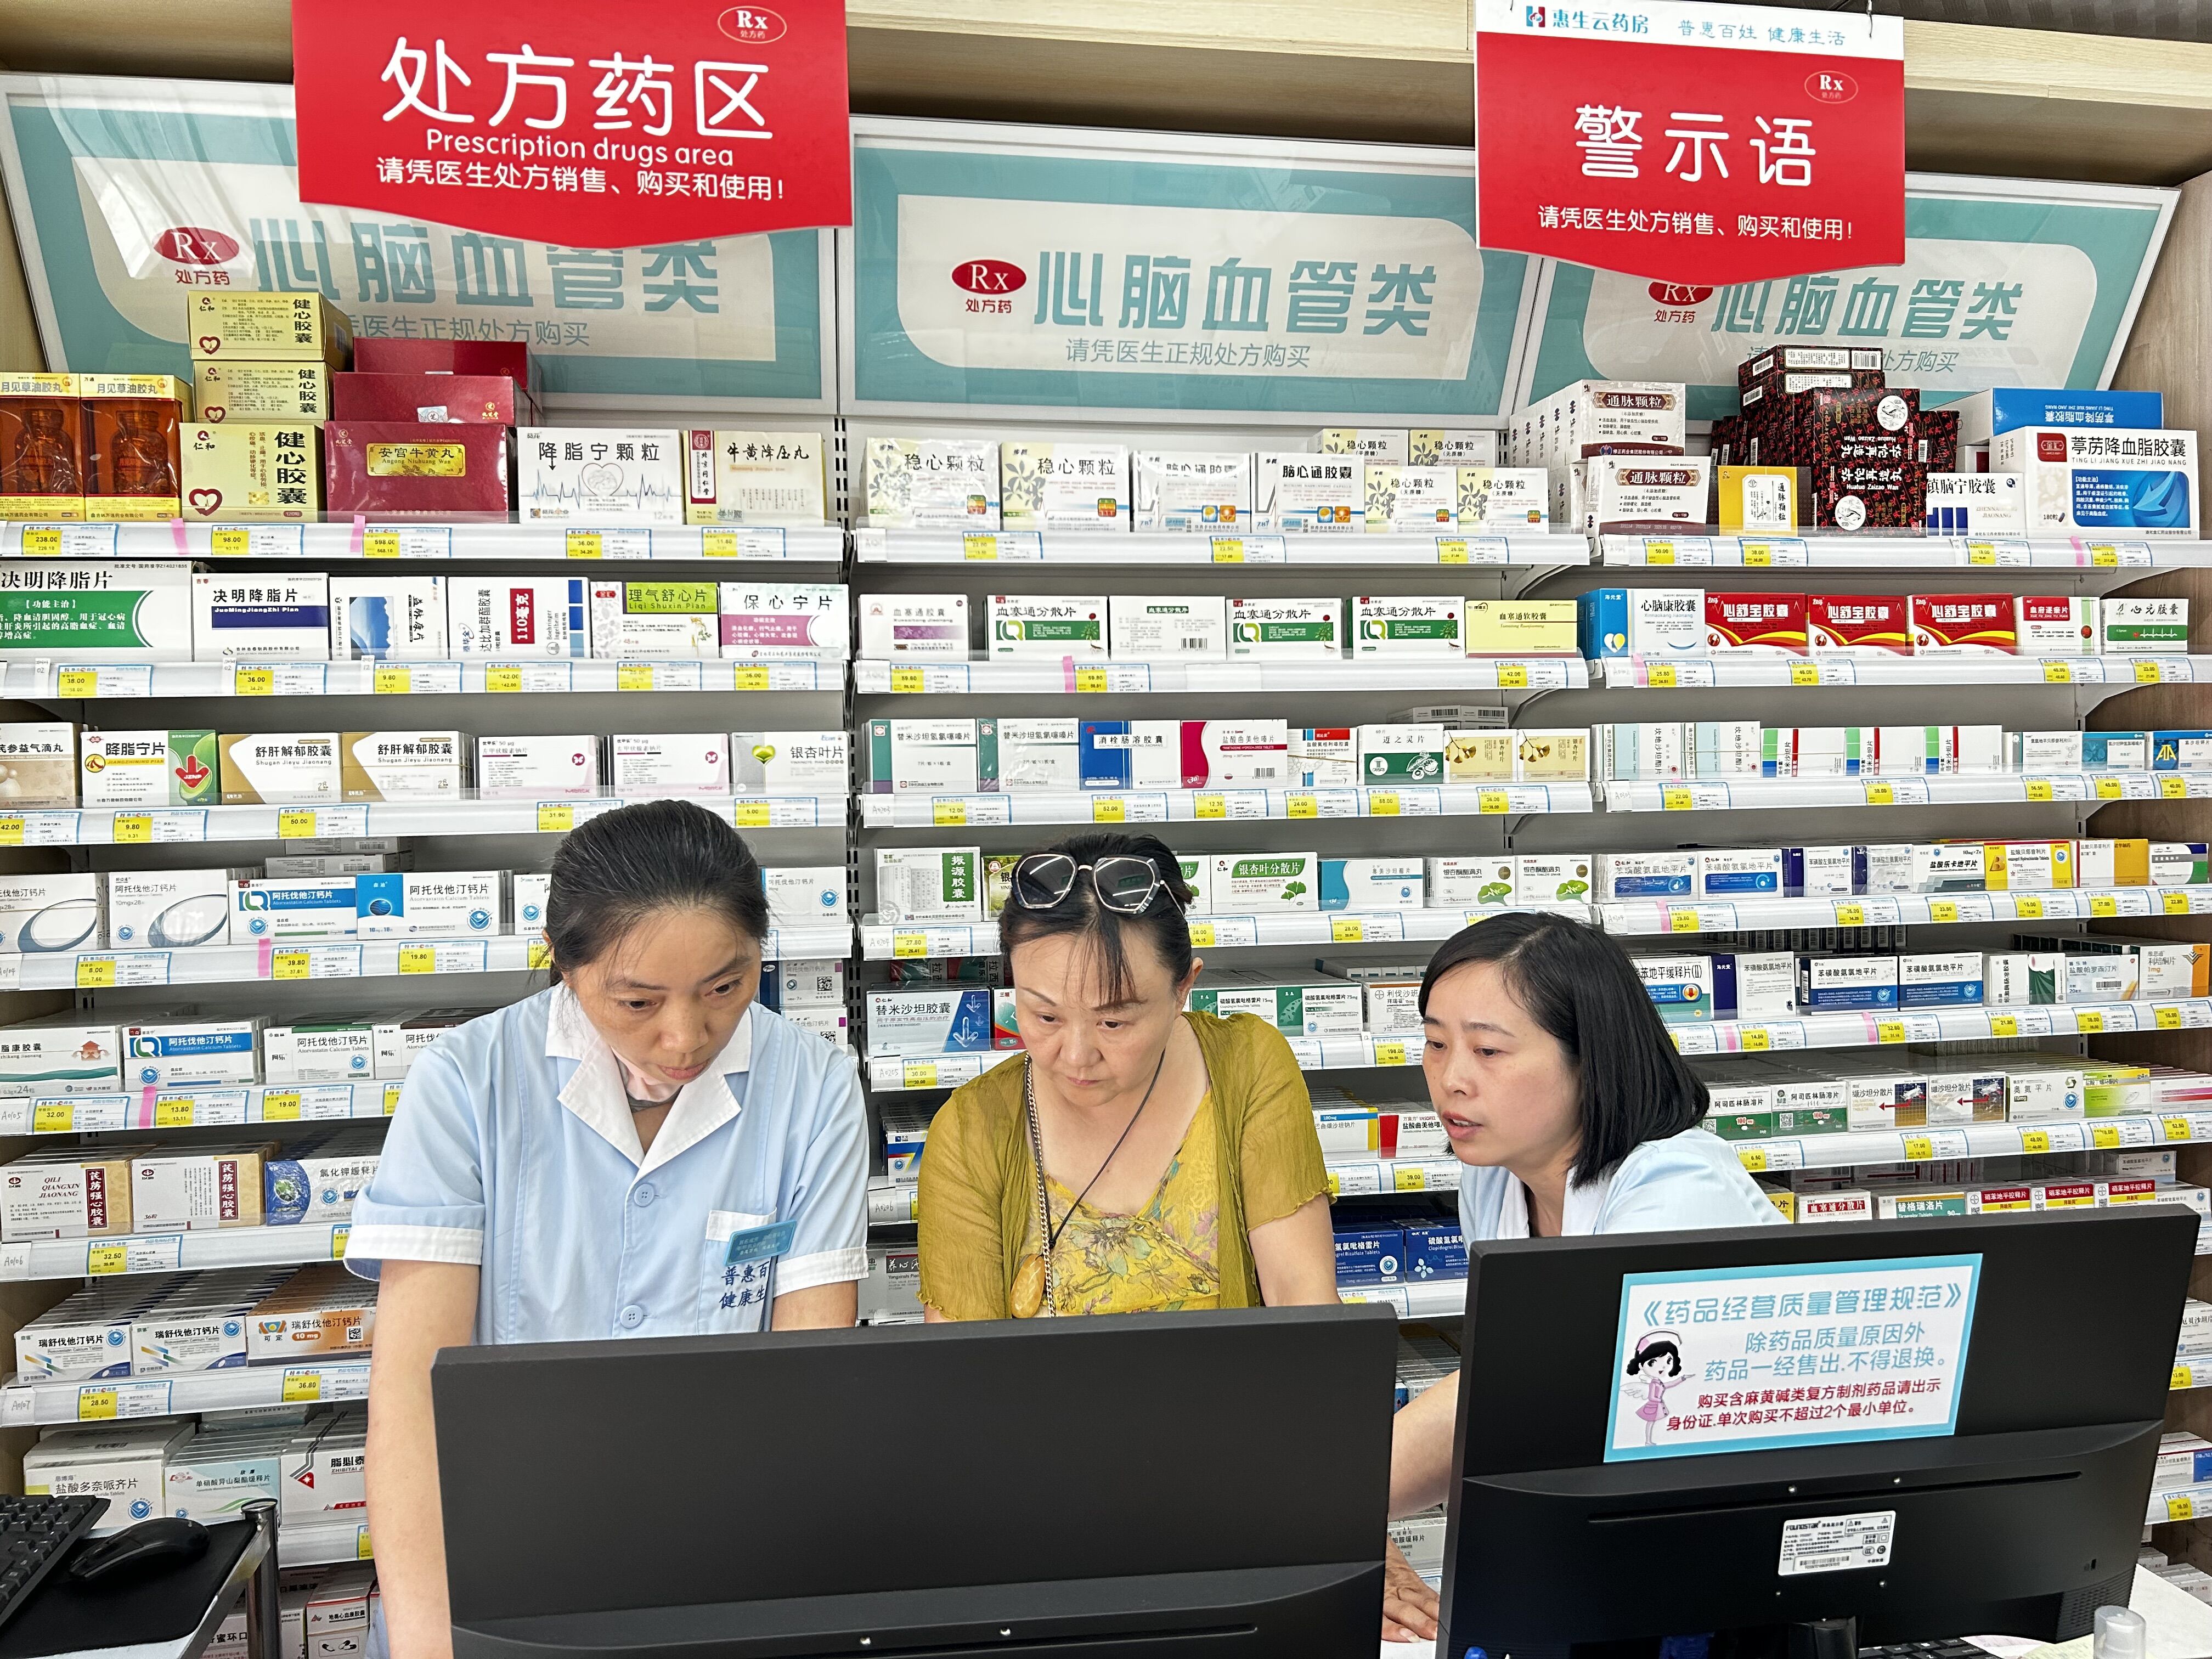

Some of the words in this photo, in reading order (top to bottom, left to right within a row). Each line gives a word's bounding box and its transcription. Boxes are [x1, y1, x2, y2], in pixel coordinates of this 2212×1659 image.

[736, 8, 768, 31] Rx
[1552, 9, 1649, 35] 惠生云药房
[740, 29, 766, 40] 处方药
[1678, 19, 1758, 41] 普惠百姓
[1768, 25, 1847, 47] 健康生活
[381, 37, 774, 139] 处方药区
[1819, 74, 1844, 91] Rx
[426, 129, 585, 160] Prescription
[593, 136, 668, 166] drugs
[675, 147, 734, 167] area
[1574, 104, 1816, 187] 警示语
[174, 231, 223, 262] Rx
[174, 268, 231, 286] 处方药
[968, 263, 1008, 291] Rx
[1034, 250, 1437, 337] 心脑血管类
[964, 297, 1012, 314] 处方药
[292, 299, 313, 343] 健心胶囊
[1653, 309, 1696, 324] 处方药
[1065, 337, 1310, 369] 请凭医生正规处方购买
[97, 382, 159, 394] 月见草油胶丸
[297, 369, 318, 414] 健心胶囊
[1607, 394, 1662, 409] 通脉颗粒
[193, 442, 216, 452] 仁和
[379, 447, 455, 459] 安宫牛黄丸
[727, 442, 810, 461] 牛黄降压丸
[1346, 439, 1387, 452] 稳心颗粒
[1434, 440, 1475, 452] 稳心颗粒
[2071, 437, 2186, 458] 葶苈降血脂胶囊
[538, 442, 661, 466] 降脂宁颗粒
[274, 431, 307, 504] 健心胶囊
[904, 454, 986, 472] 稳心颗粒
[1038, 458, 1117, 476] 稳心颗粒
[1282, 464, 1353, 480] 脑心通胶囊
[1629, 471, 1686, 485] 通脉颗粒
[2, 571, 114, 590] 决明降脂片
[213, 588, 298, 603] 决明降脂片
[629, 589, 707, 602] 理气舒心片
[744, 595, 833, 610] 保心宁片
[1641, 600, 1696, 612] 心脑康胶囊
[515, 593, 529, 640] 110毫克
[1098, 735, 1165, 745] 消栓肠溶胶囊
[105, 742, 165, 757] 降脂宁片
[255, 745, 332, 757] 舒肝解郁胶囊
[377, 743, 453, 755] 舒肝解郁胶囊
[790, 745, 844, 760] 银杏叶片
[1238, 861, 1301, 876] 银杏叶分散片
[951, 855, 966, 899] 振源胶囊
[114, 883, 177, 894] 阿托伐他汀钙片
[272, 890, 334, 901] 阿托伐他汀钙片
[409, 883, 489, 895] 阿托伐他汀钙片
[875, 1002, 951, 1015] 替米沙坦胶囊
[168, 1035, 233, 1046] 阿托伐他汀钙片
[297, 1036, 368, 1047] 阿托伐他汀钙片
[89, 1171, 105, 1226] 芪苈强心胶囊
[221, 1163, 236, 1218] 芪苈强心胶囊
[1643, 1282, 1962, 1326] 《药品经营质量管理规范》
[291, 1316, 362, 1329] 瑞舒伐他汀钙片
[155, 1325, 221, 1339] 瑞舒伐他汀钙片
[1745, 1321, 1925, 1354] 除药品质量原因外
[38, 1334, 104, 1348] 瑞舒伐他汀钙片
[1697, 1378, 1942, 1408] 购买含麻黄碱类复方制剂药品请出示
[56, 1479, 138, 1495] 盐酸多奈哌齐片
